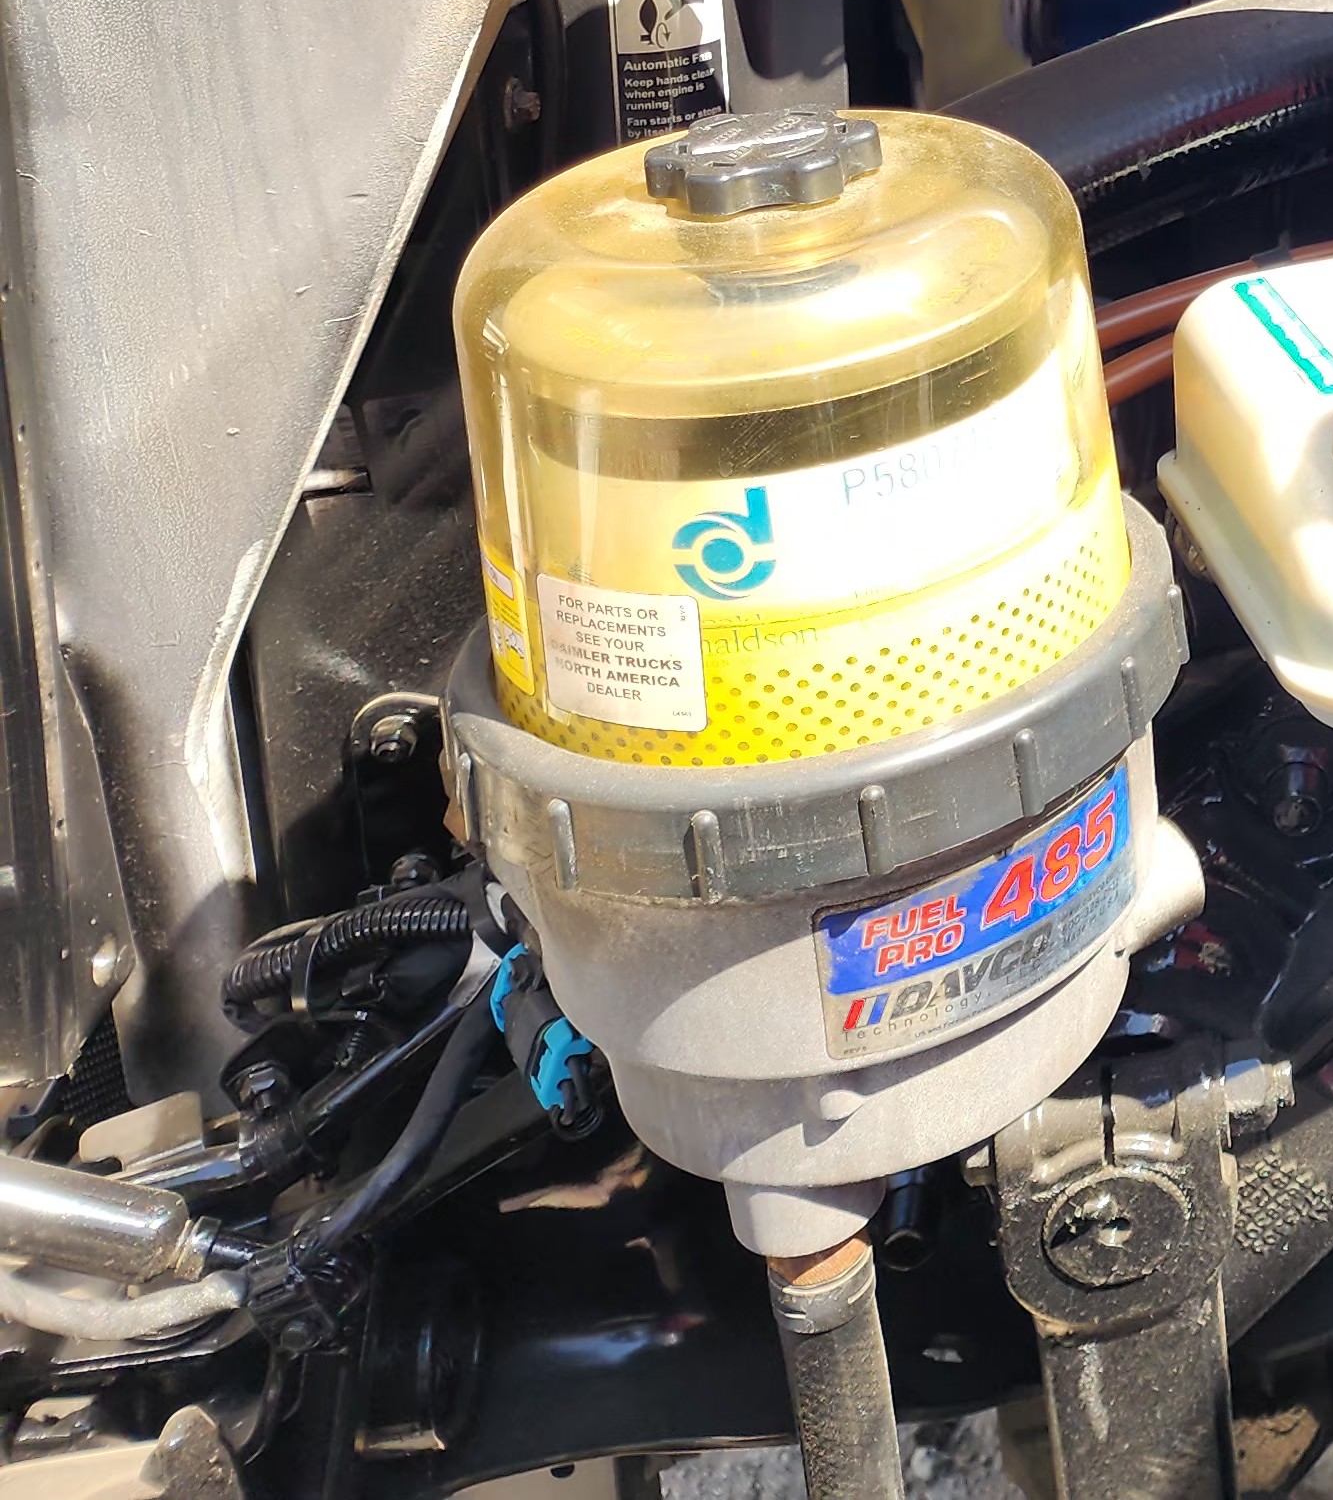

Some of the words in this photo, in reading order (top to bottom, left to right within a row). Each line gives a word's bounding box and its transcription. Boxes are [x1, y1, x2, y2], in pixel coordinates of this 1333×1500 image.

[623, 54, 689, 72] Automatic
[692, 51, 712, 65] Fan
[625, 77, 653, 89] Keep
[657, 71, 689, 86] hands
[691, 67, 715, 80] clear
[625, 88, 655, 99] when
[658, 84, 694, 98] engine
[695, 83, 705, 92] is
[625, 101, 673, 111] running.
[626, 115, 647, 128] Fan
[650, 113, 682, 126] starts
[685, 111, 697, 122] or
[698, 104, 723, 119] stops
[628, 126, 641, 140] by
[559, 595, 584, 611] FOR
[588, 602, 633, 618] PARTS
[637, 609, 658, 620] OR
[556, 610, 666, 637] REPLACEMENTS
[576, 631, 601, 646] SEE
[604, 636, 645, 652] YOUR
[700, 626, 819, 656] naldson
[550, 639, 611, 664] DAIMLER
[615, 654, 683, 671] TRUCKS
[555, 658, 601, 678] NORTH
[606, 669, 680, 687] AMERICA
[587, 682, 642, 701] DEALER
[980, 788, 1116, 931] 485
[862, 894, 967, 949] FUEL
[875, 924, 966, 976] PRO
